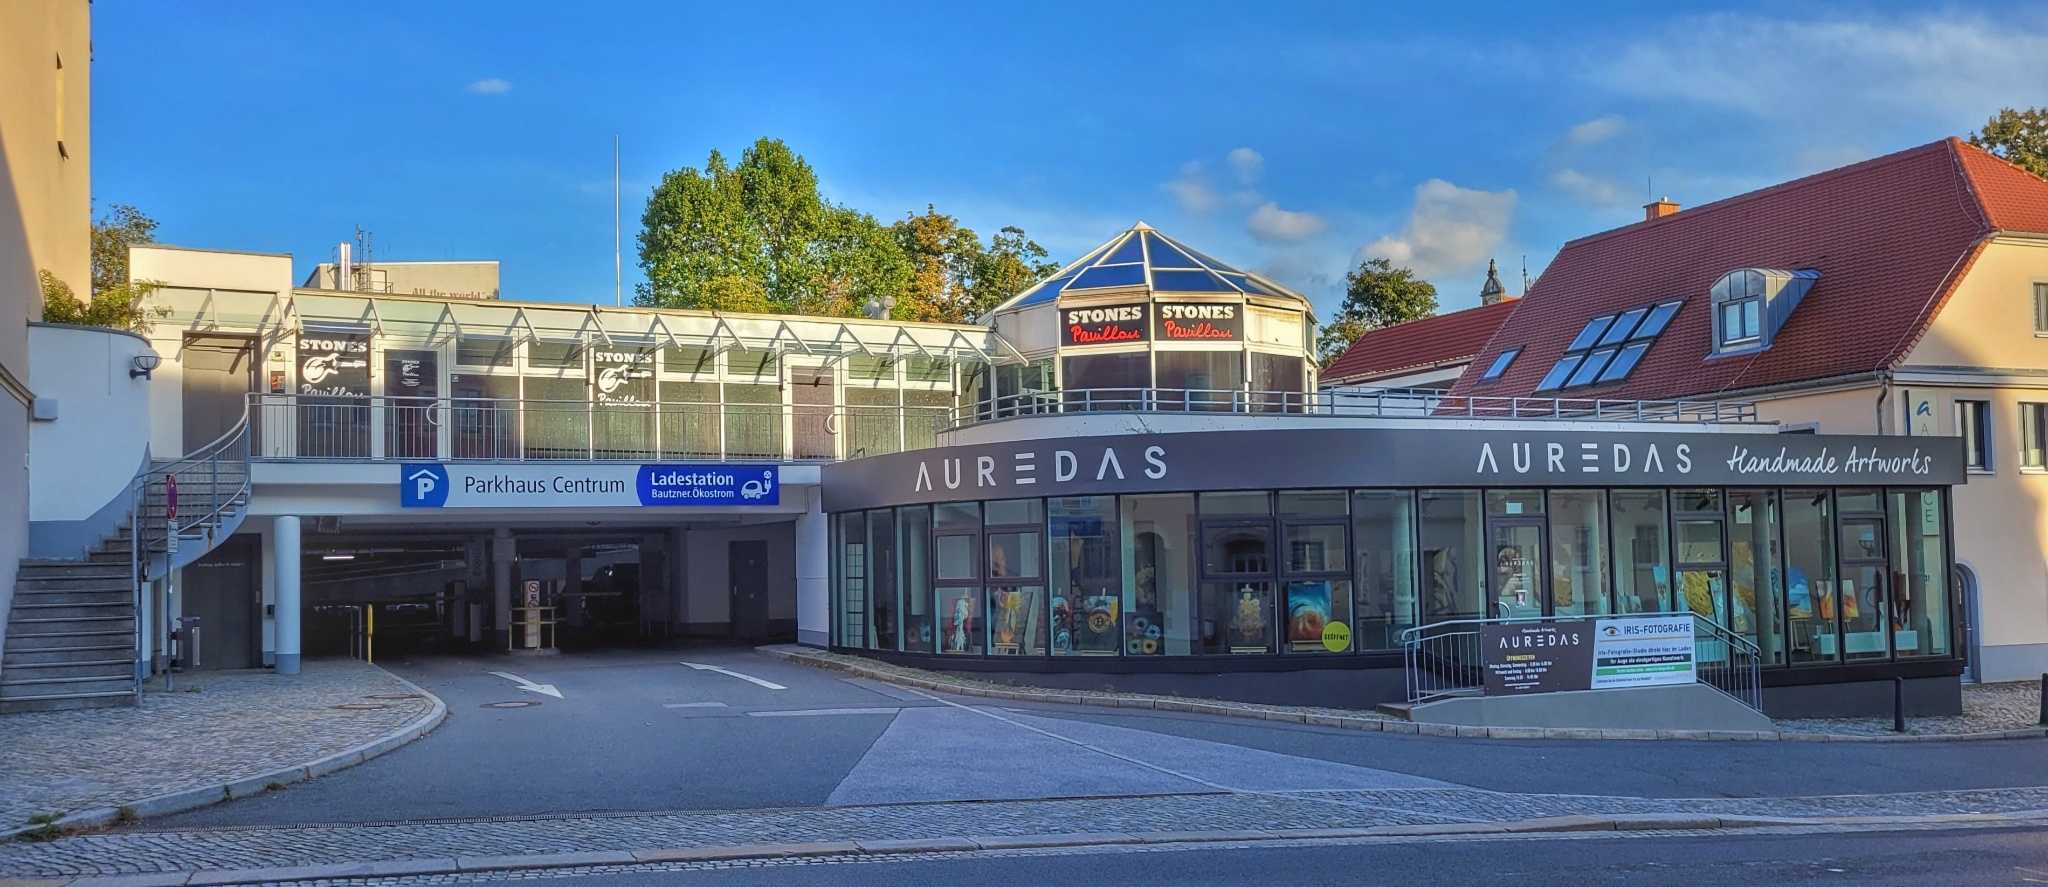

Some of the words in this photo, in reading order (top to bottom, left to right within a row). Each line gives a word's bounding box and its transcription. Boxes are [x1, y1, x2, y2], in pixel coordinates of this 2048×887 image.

[1069, 306, 1142, 324] STONES
[1162, 305, 1235, 319] STONES
[1070, 324, 1140, 343] Pavillon
[1164, 320, 1232, 338] Pavillon
[300, 338, 367, 353] STONES
[595, 351, 652, 363] STONES
[1476, 442, 1692, 473] AUREDAS
[1726, 445, 1839, 474] Handmade
[1844, 446, 1931, 474] Artworks
[914, 446, 1167, 492] AUREDAS
[464, 475, 546, 494] Parkhaus
[552, 475, 625, 494] Centrum
[651, 471, 734, 487] Ladestation
[651, 486, 735, 499] Bautzner.Ökostrom
[1324, 633, 1349, 641] GEÖFFNET
[1500, 633, 1579, 649] AUREDAS
